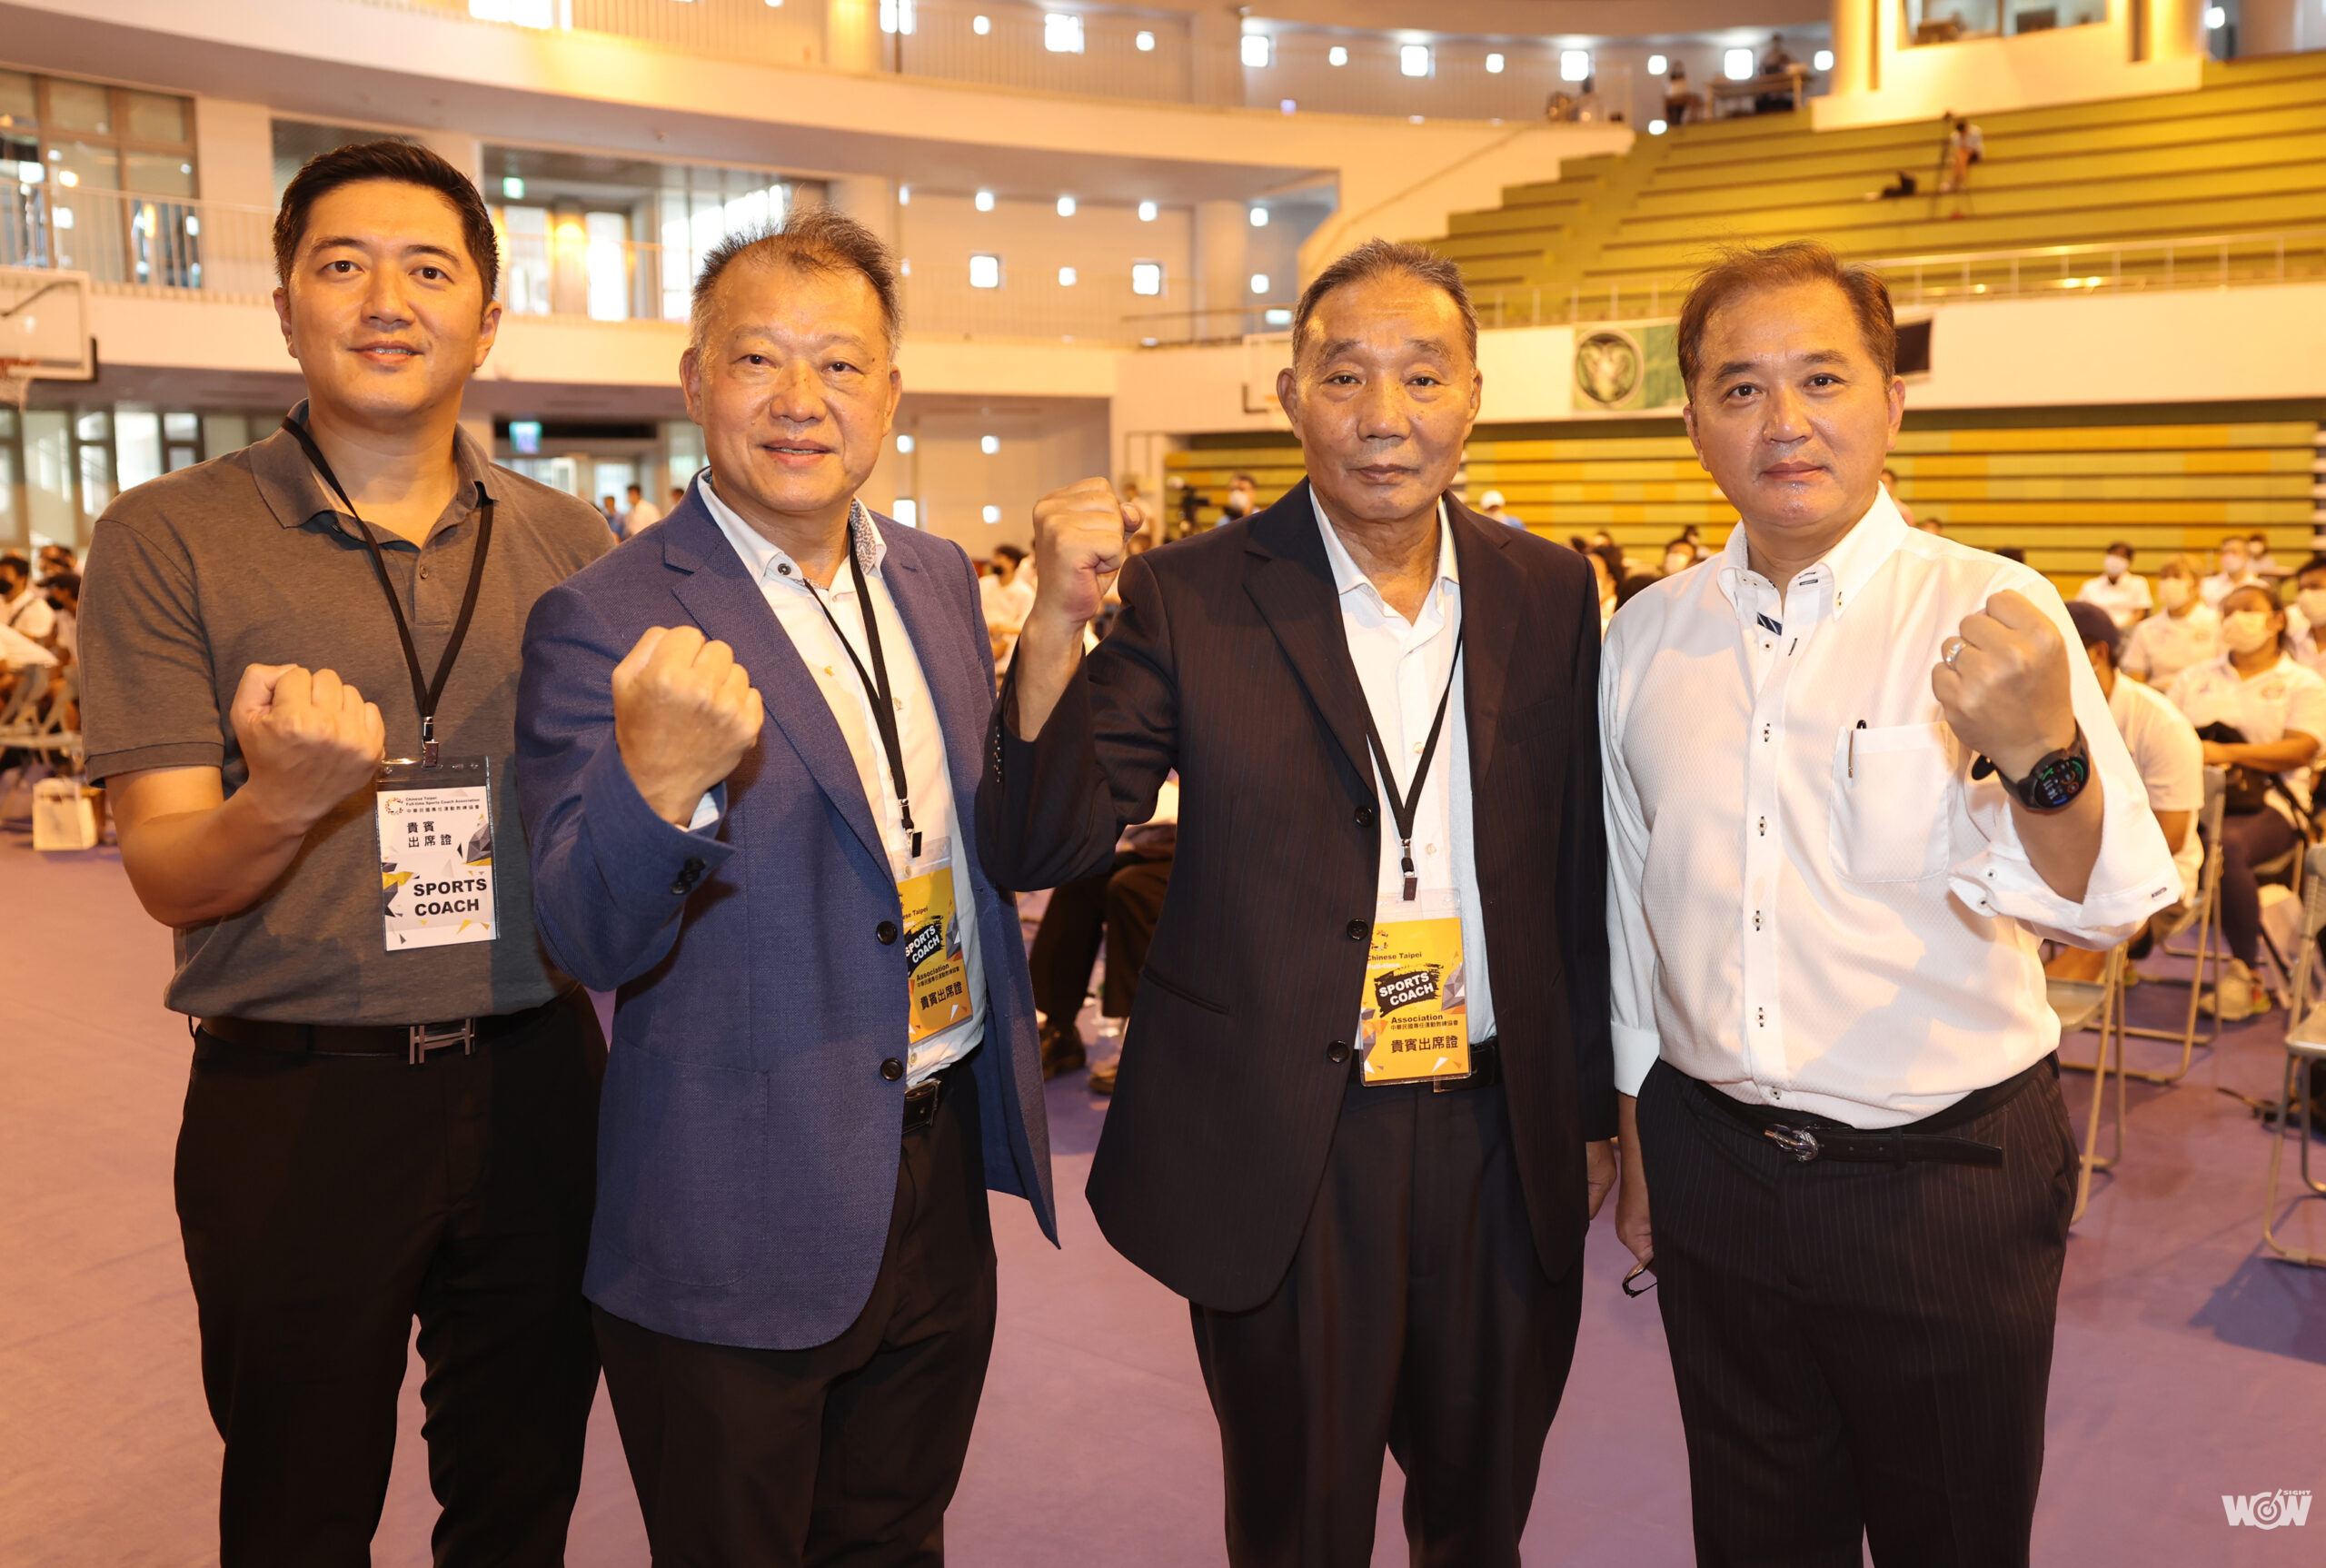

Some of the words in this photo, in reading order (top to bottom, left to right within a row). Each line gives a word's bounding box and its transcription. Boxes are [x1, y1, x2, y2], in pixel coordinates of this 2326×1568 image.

[407, 820, 434, 834] 貴賓
[408, 834, 452, 848] 出席證
[413, 878, 487, 897] SPORTS
[414, 898, 480, 917] COACH
[905, 926, 936, 958] SPORTS
[912, 935, 939, 963] COACH
[916, 963, 949, 981] Association
[1378, 972, 1430, 997] SPORTS
[1389, 982, 1434, 1006] COACH
[1391, 1014, 1443, 1024] Association
[1391, 1035, 1458, 1054] 貴賓出席證
